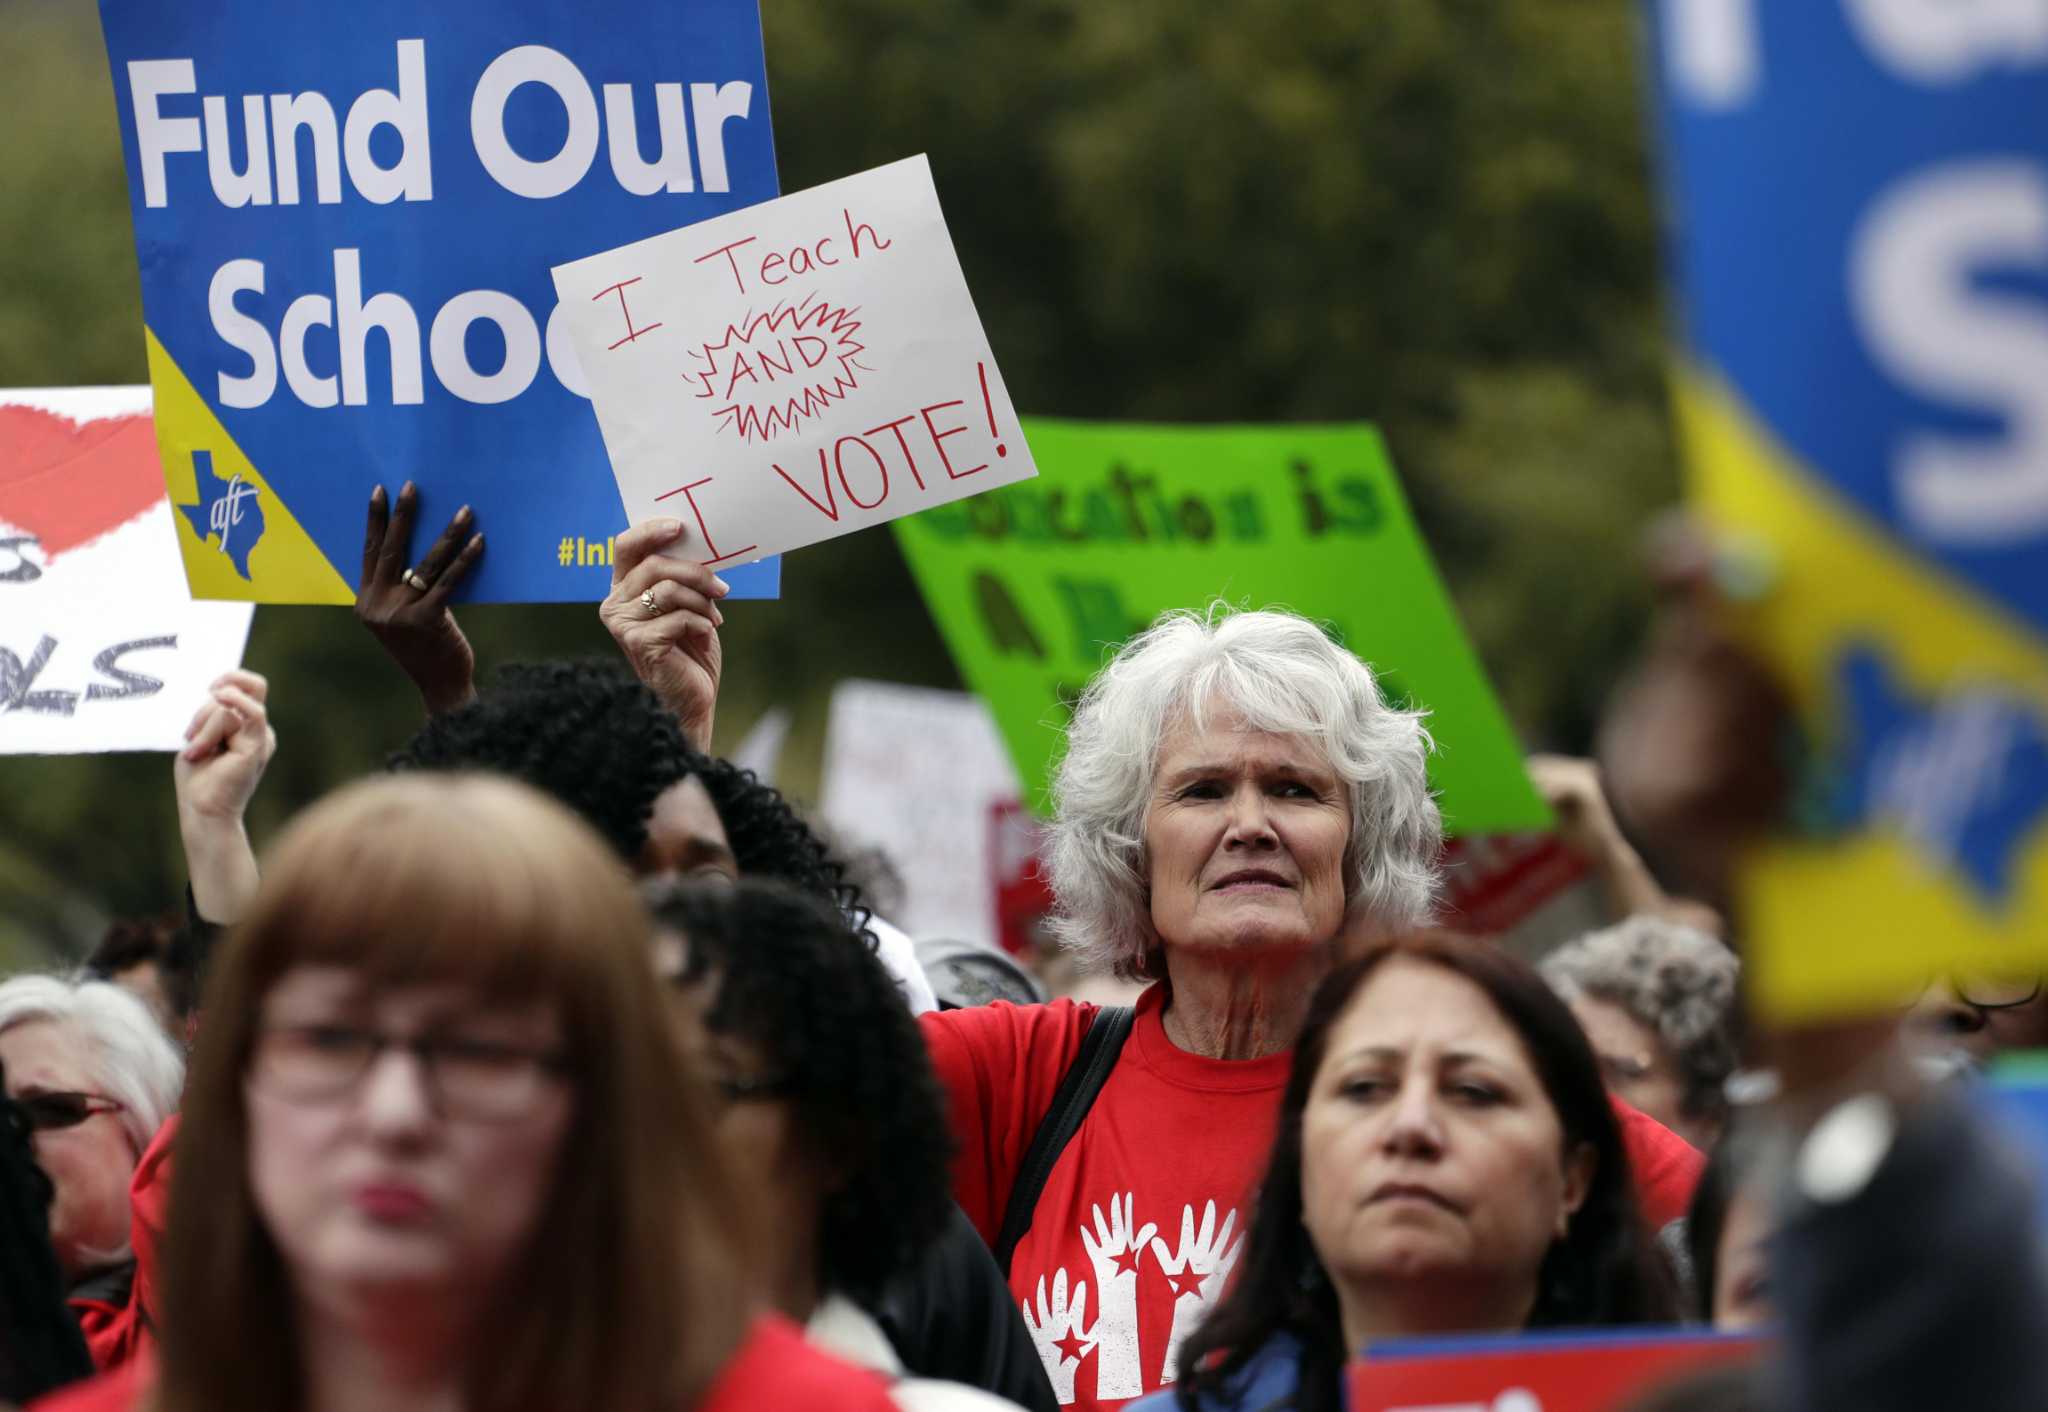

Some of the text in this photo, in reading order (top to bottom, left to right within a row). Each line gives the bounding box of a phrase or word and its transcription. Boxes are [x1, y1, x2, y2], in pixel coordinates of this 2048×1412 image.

[127, 39, 753, 208] Fund Our
[592, 208, 892, 351] I Teach
[726, 335, 828, 400] AND
[210, 472, 260, 553] aft
[655, 361, 1009, 566] I VOTE!
